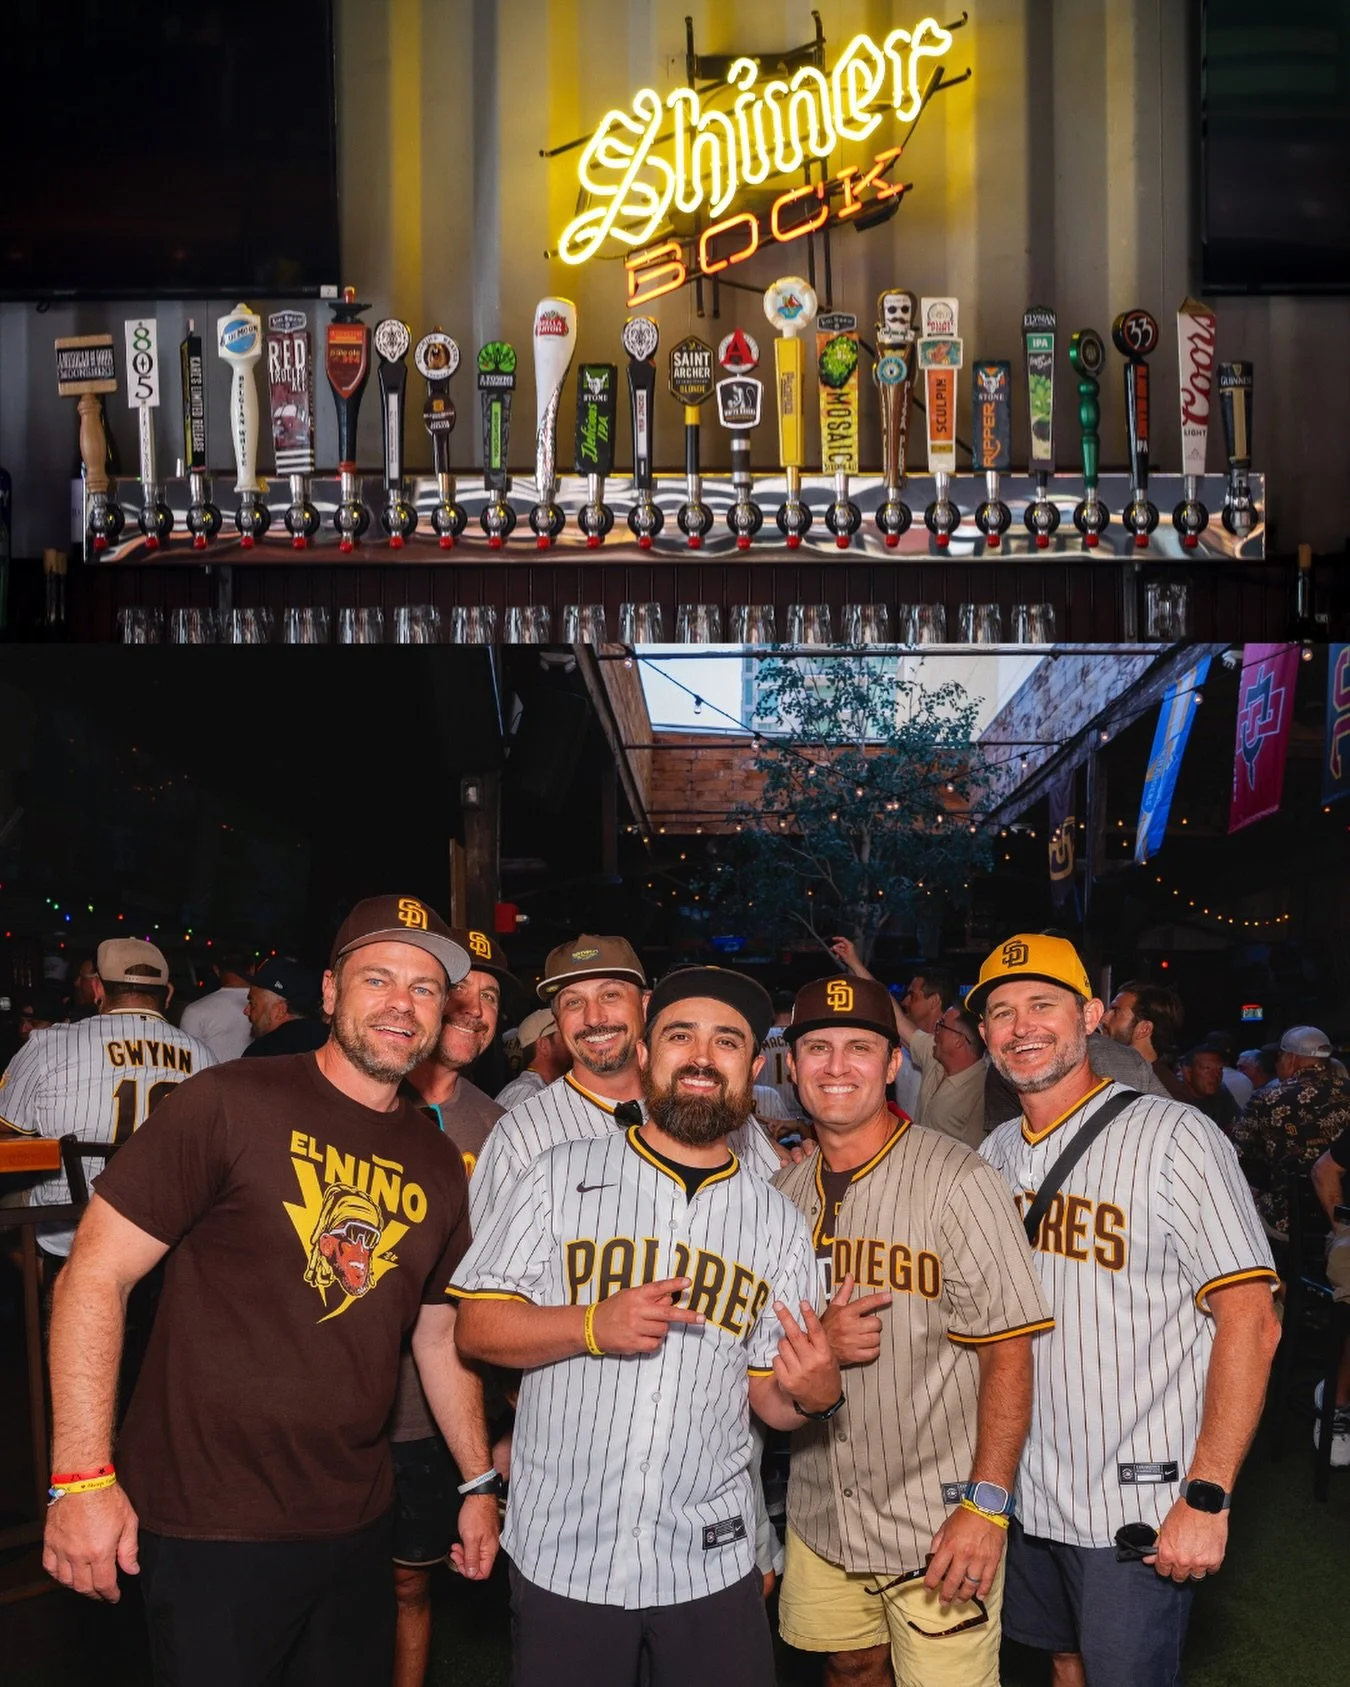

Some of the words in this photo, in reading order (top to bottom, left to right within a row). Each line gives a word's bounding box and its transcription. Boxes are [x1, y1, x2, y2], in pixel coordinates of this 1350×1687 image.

[558, 17, 953, 266] Shiner
[625, 146, 906, 307] BOCK
[236, 324, 259, 340] MOON
[1032, 337, 1049, 348] IPA
[1127, 317, 1154, 350] 33
[131, 326, 155, 400] 805
[268, 339, 306, 370] RED
[673, 351, 711, 367] SAINT
[1180, 312, 1217, 427] Coors
[269, 367, 306, 385] TROLLEY
[673, 366, 711, 379] ARCHER
[191, 386, 204, 417] LIMITED
[583, 393, 609, 402] STONE
[936, 378, 948, 433] SCULPIN
[978, 393, 1004, 401] STONE
[193, 418, 205, 453] RELEASE
[826, 391, 853, 463] MOSAIC
[982, 402, 1001, 468] RIPPER
[1183, 429, 1208, 438] LIGHT
[238, 429, 248, 467] WHITE
[398, 898, 429, 930] SD
[468, 931, 492, 960] SD
[1001, 940, 1030, 969] SD
[826, 980, 854, 1012] SD
[106, 1039, 193, 1075] GWYNN
[112, 1077, 184, 1144] 1
[289, 1130, 324, 1164] EL
[323, 1142, 429, 1224] NIÑO
[833, 1239, 943, 1300] DIEGO
